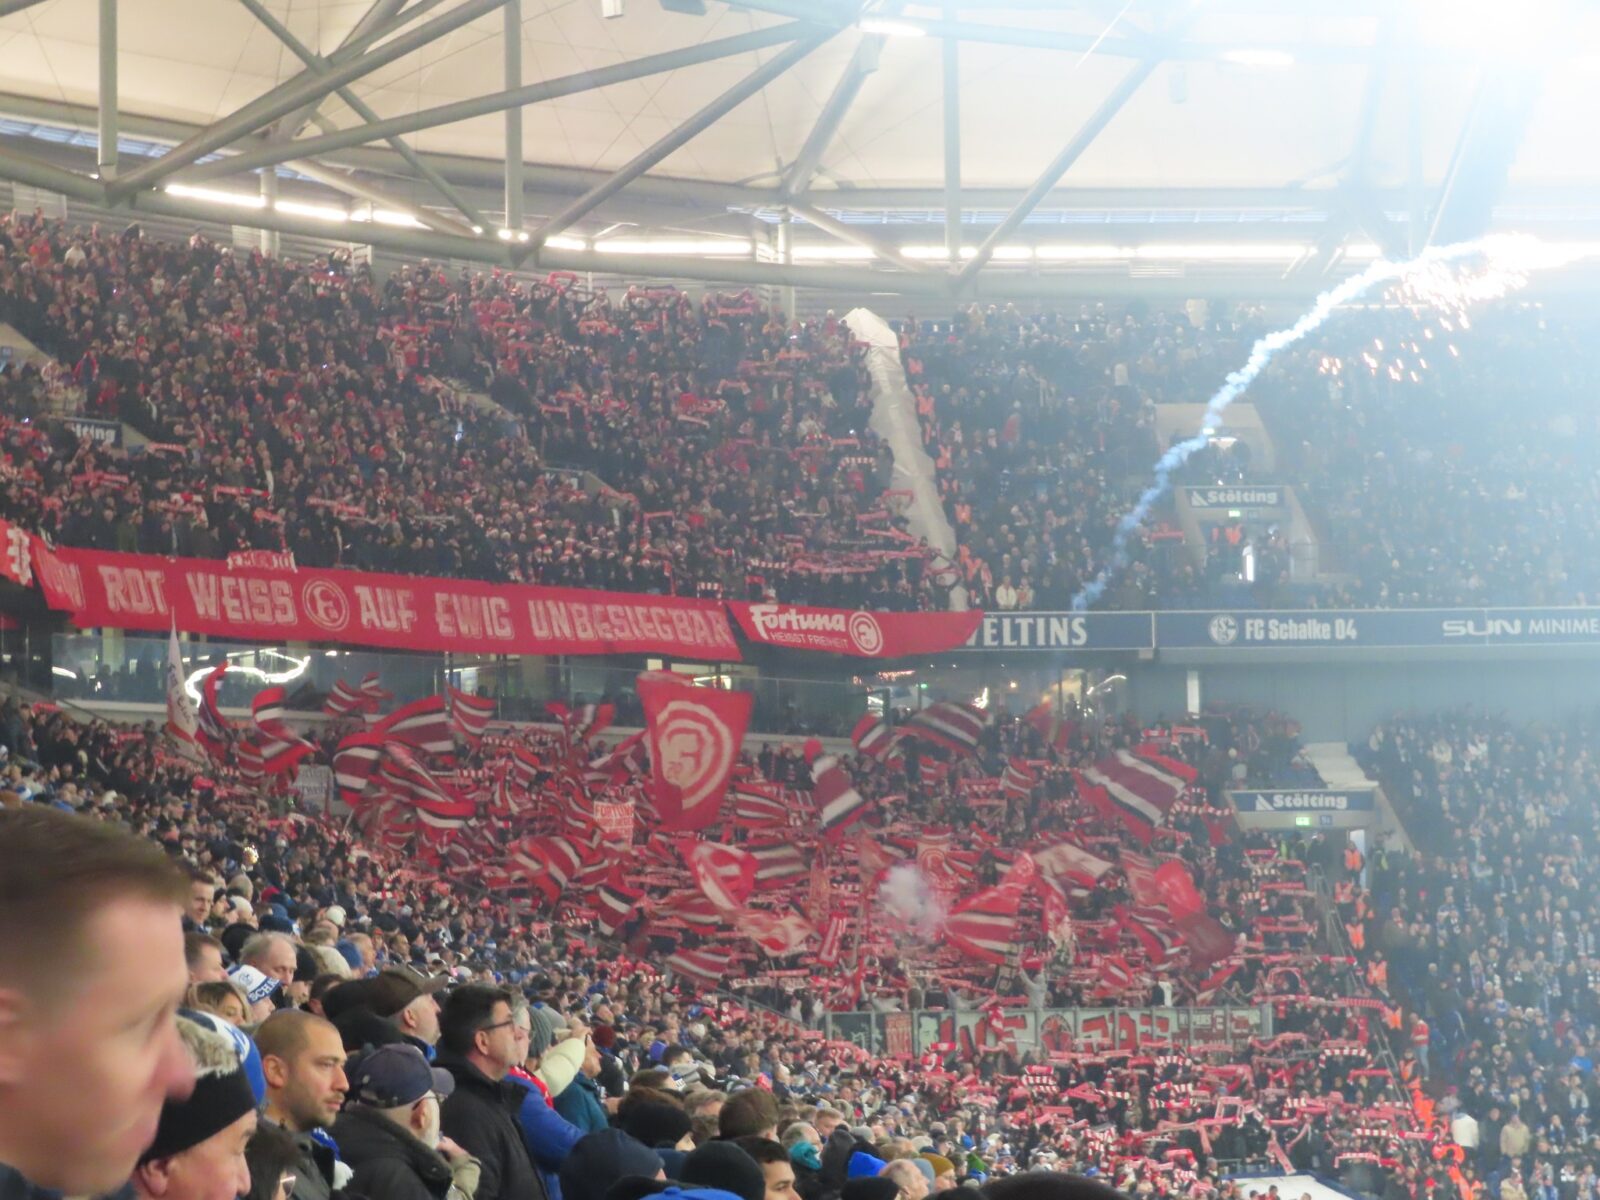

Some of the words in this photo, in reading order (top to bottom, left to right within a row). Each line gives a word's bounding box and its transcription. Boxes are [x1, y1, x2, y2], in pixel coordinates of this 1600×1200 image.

[71, 422, 116, 443] lting
[1207, 489, 1277, 504] Stölting
[98, 565, 168, 615] ROT
[186, 571, 297, 625] WEISS
[354, 585, 417, 633] AUF
[435, 592, 514, 640] EWIG
[749, 604, 846, 640] Fortuna
[1245, 618, 1264, 640] FC
[1268, 618, 1331, 640] Schalke
[1335, 618, 1358, 640] 04
[1442, 619, 1521, 636] SUN
[1273, 792, 1347, 810] Stölting
